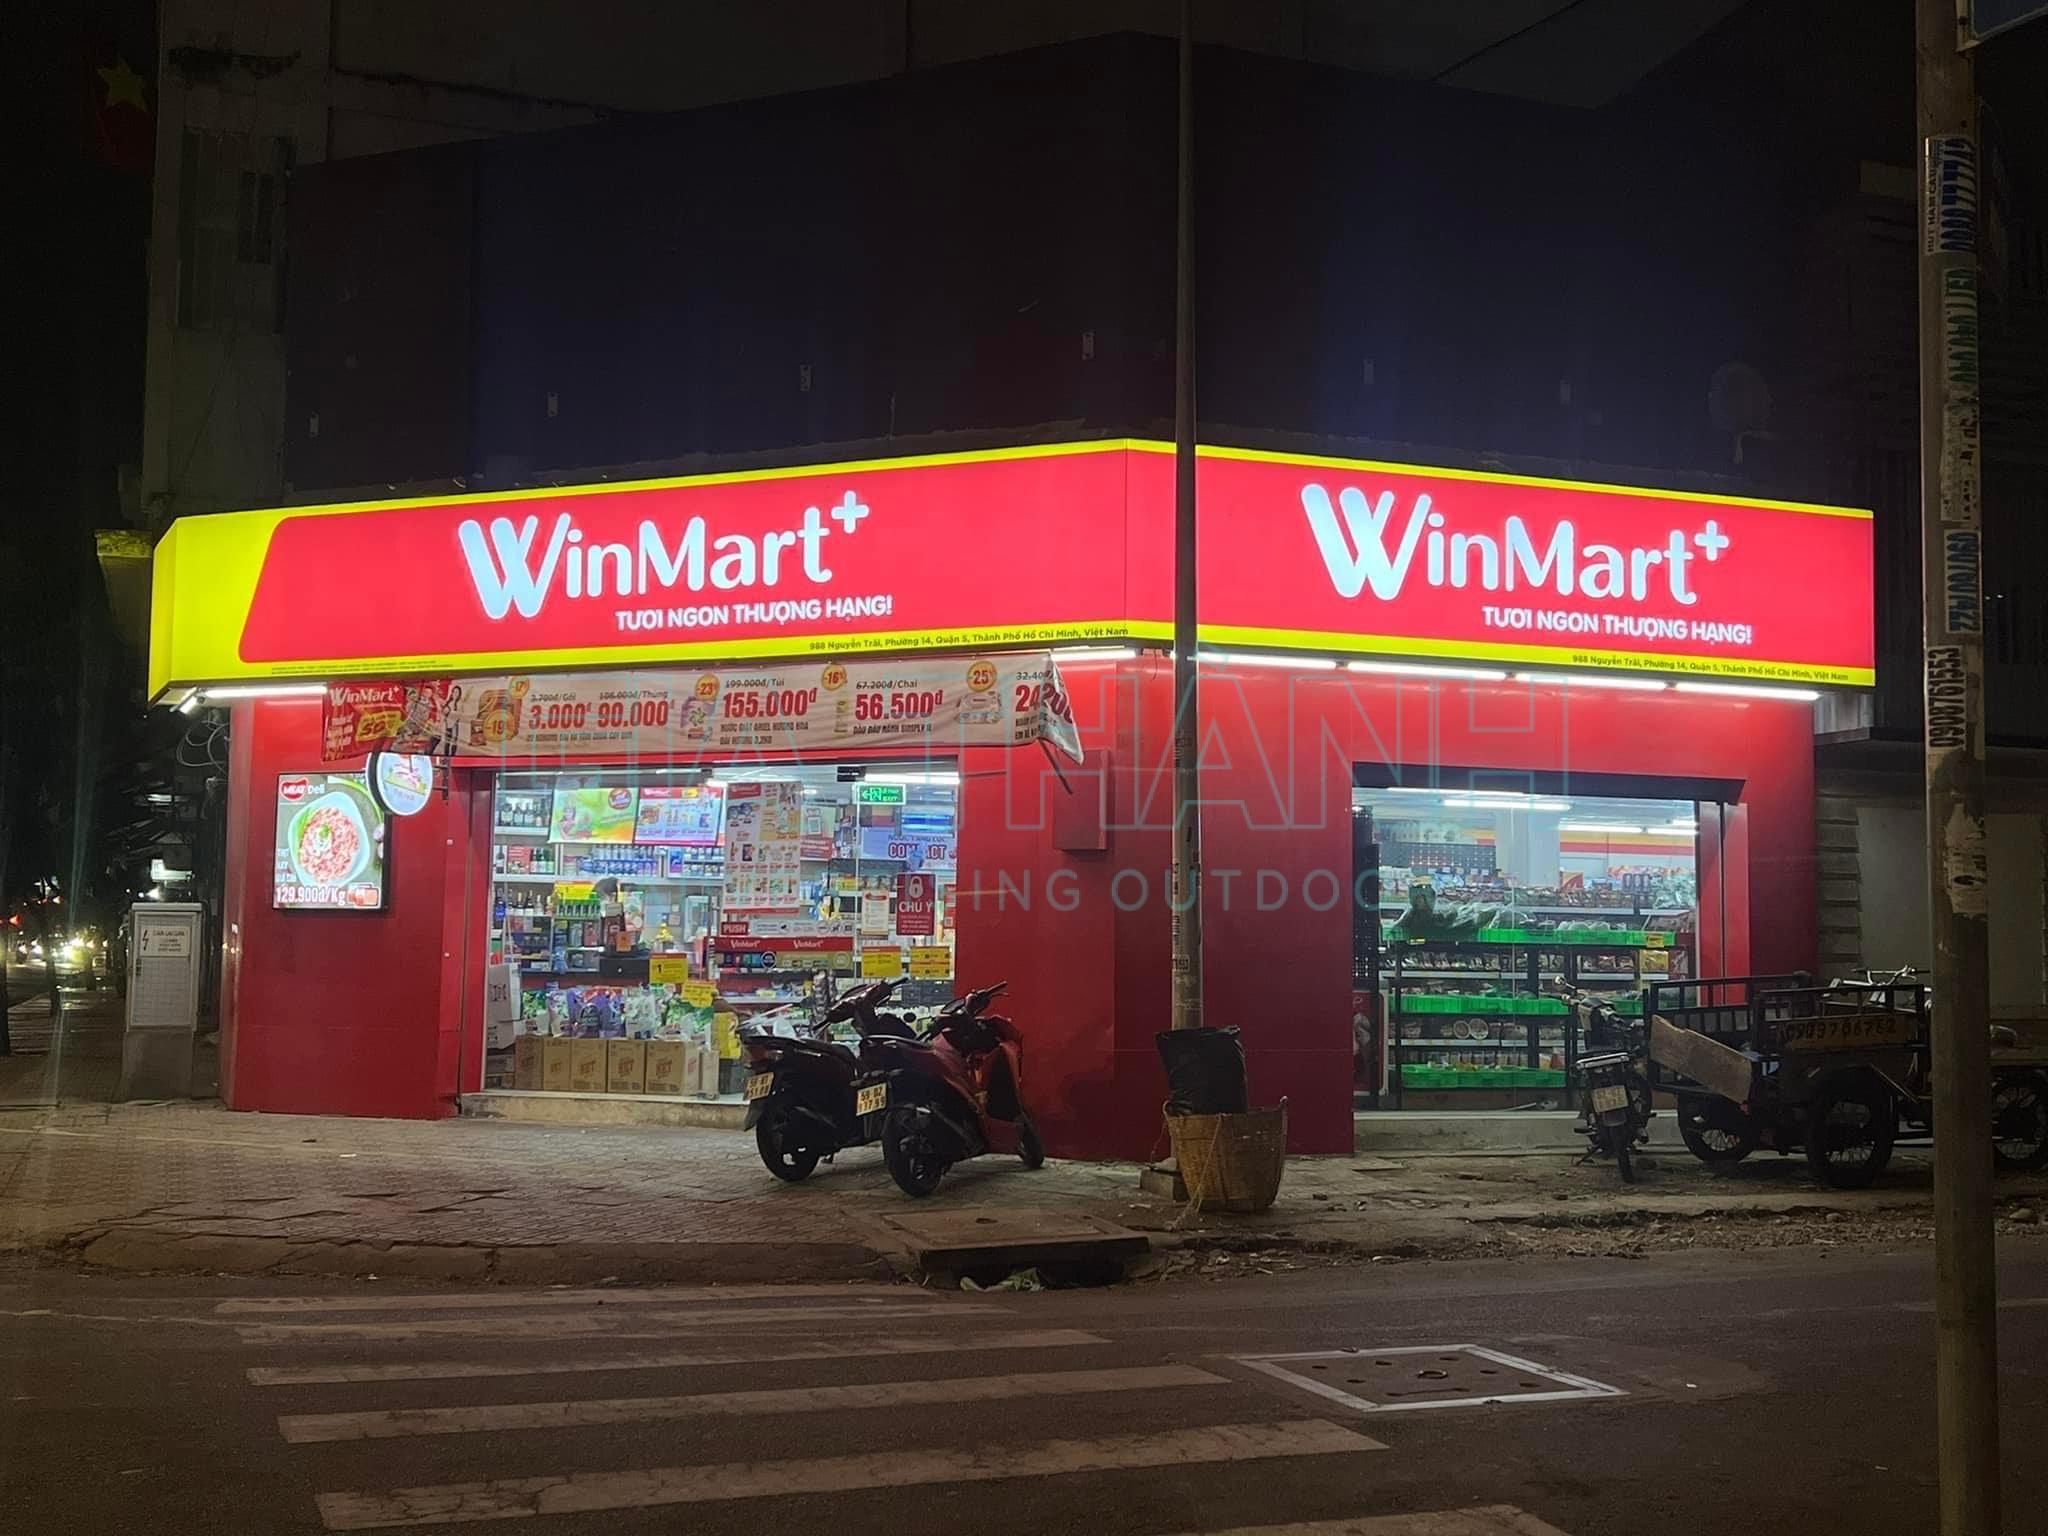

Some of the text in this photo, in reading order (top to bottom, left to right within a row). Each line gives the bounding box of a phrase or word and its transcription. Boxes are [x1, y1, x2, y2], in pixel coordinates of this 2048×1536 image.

[458, 489, 870, 620] WinMart+
[1300, 482, 1729, 605] WinMart+
[616, 595, 893, 630] TƯƠI NGON THƯỢNG HẠNG!
[1482, 606, 1752, 645] TƯƠI NGON THƯỢNG HẠNG!
[810, 642, 826, 650] 988
[828, 639, 862, 651] Nguyễn
[885, 636, 919, 648] Phường
[921, 636, 934, 646] 14,
[936, 634, 961, 645] Quận
[962, 634, 970, 644] 5,
[973, 631, 1001, 642] Thành
[1003, 629, 1021, 640] Phố
[1055, 628, 1081, 639] Minh,
[1084, 627, 1103, 638] Việt
[1106, 627, 1128, 637] Nam
[1590, 655, 1622, 667] Nguyễn
[1644, 659, 1675, 671] Phường
[1677, 662, 1688, 672] 14,
[1722, 664, 1746, 674] Thành
[1831, 672, 1849, 681] Nam
[724, 688, 818, 718] 155.000đ
[855, 688, 944, 720] 56.500đ
[1928, 648, 1965, 748] 0908761553
